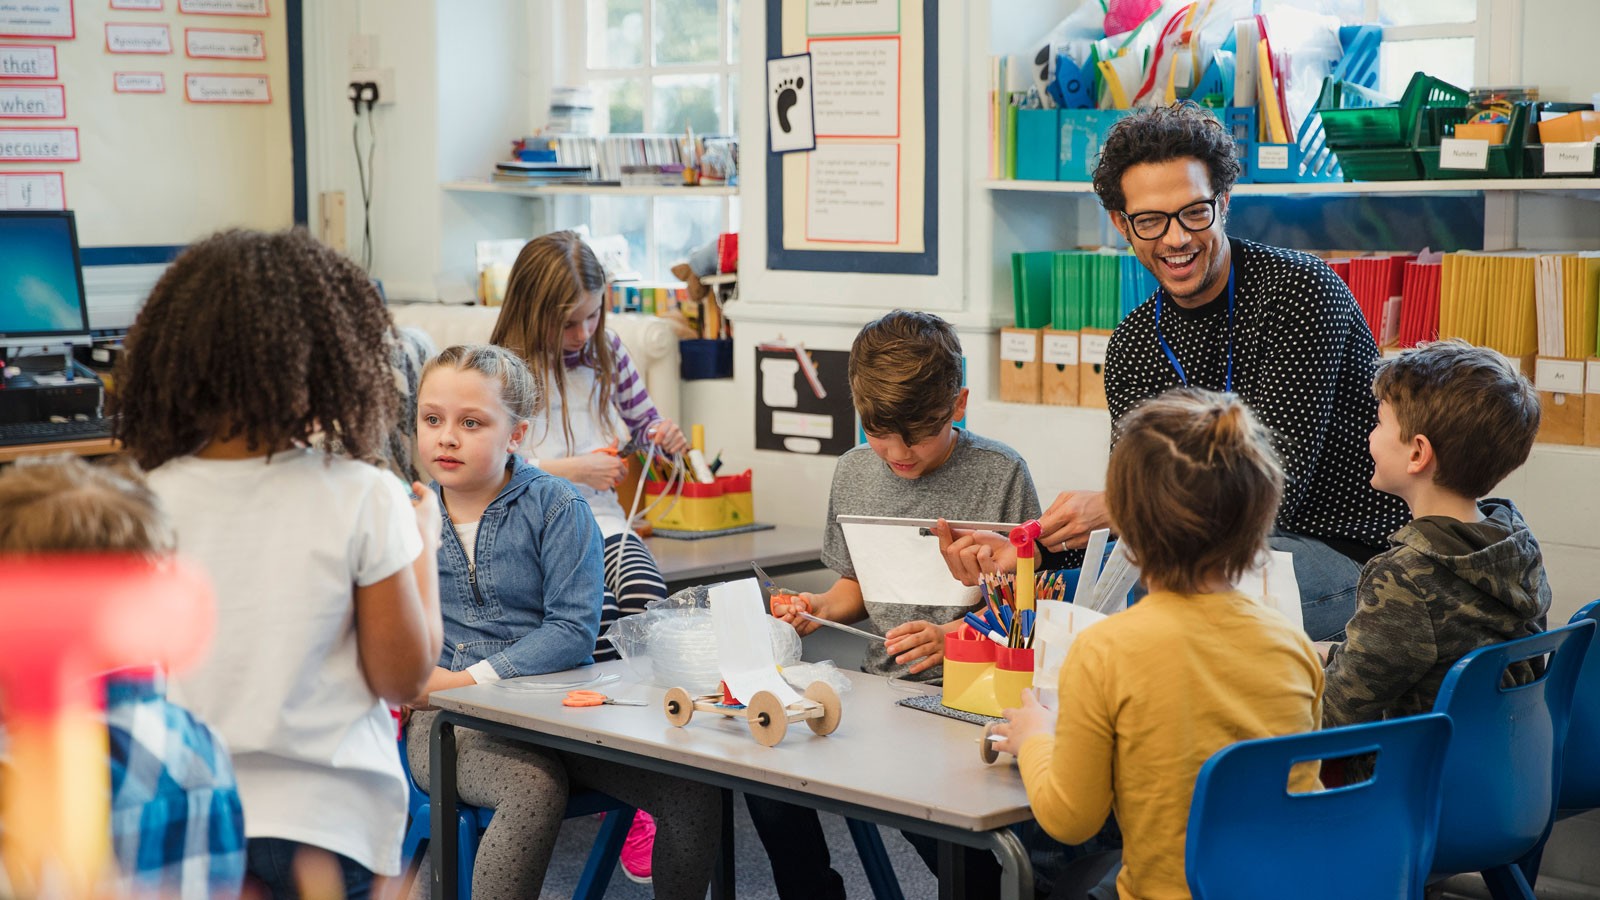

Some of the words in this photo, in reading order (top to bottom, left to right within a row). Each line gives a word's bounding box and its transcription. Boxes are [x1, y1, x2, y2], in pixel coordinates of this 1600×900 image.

[4, 54, 37, 74] that
[0, 94, 45, 113] when
[1558, 152, 1580, 162] Money
[21, 181, 32, 208] if
[1554, 372, 1565, 380] Art
